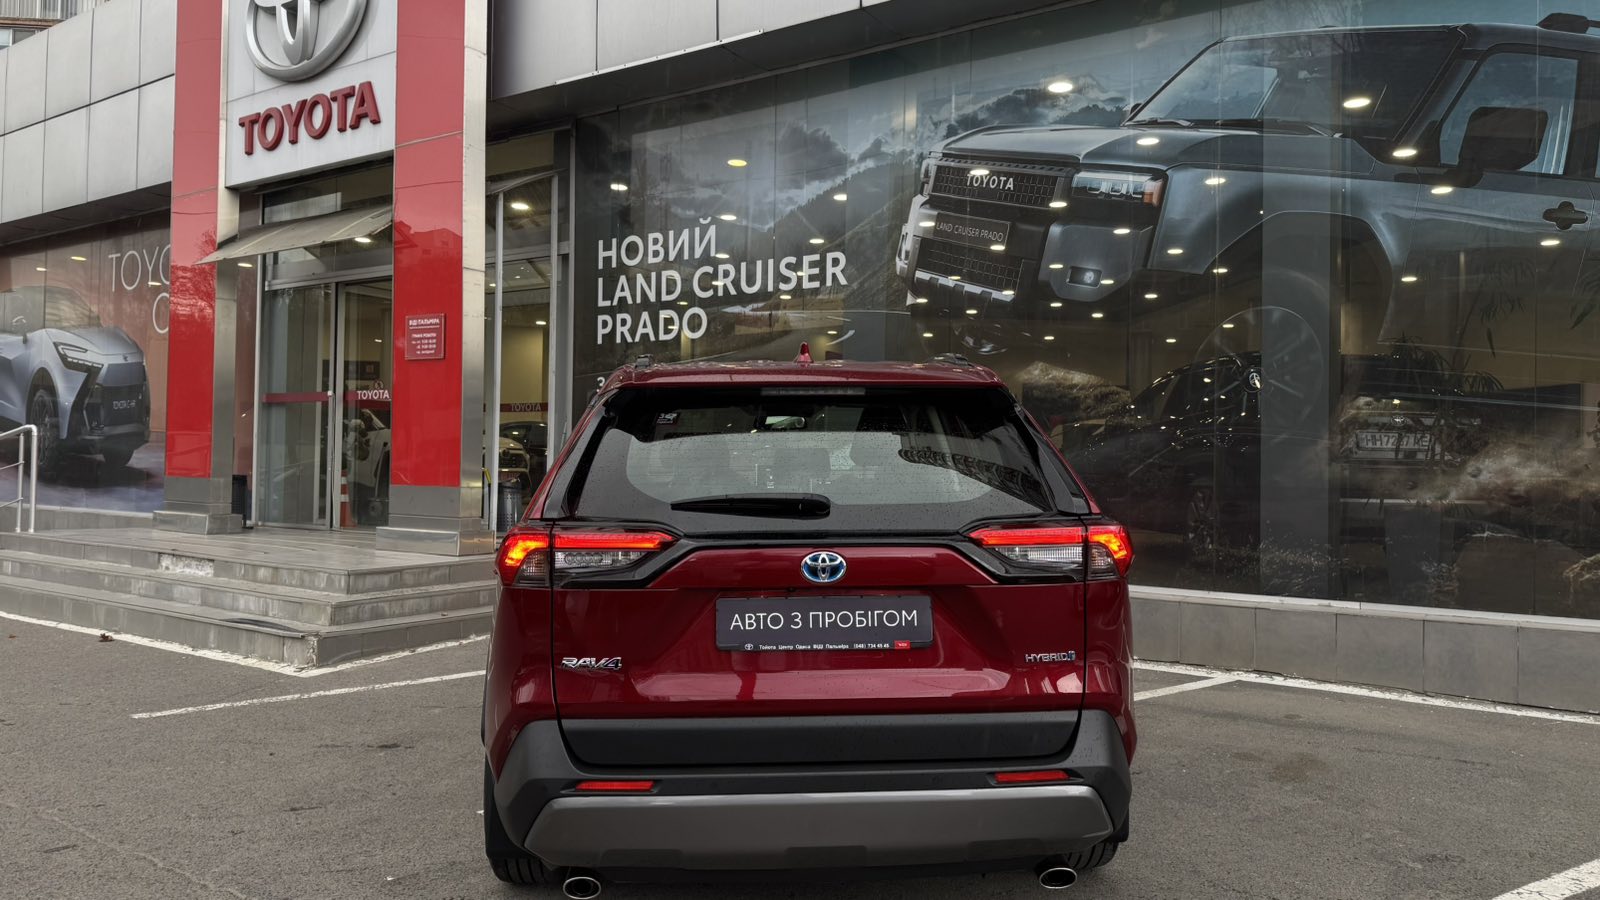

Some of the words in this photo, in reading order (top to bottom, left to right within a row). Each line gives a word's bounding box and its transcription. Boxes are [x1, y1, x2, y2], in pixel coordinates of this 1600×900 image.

[238, 81, 381, 156] TOYOTA
[966, 173, 1014, 191] TOYOTA
[936, 221, 953, 232] LAND
[953, 225, 980, 238] CRUISER
[980, 229, 1004, 242] PRADO
[597, 216, 717, 270] НОВИЙ
[597, 269, 682, 307] LAND
[692, 251, 848, 299] CRUISER
[597, 306, 708, 345] PRADO
[357, 389, 390, 400] TOYOTA
[511, 403, 542, 412] TOYOTA
[729, 612, 784, 631] АВТО
[809, 609, 918, 629] ПРОБІГОМ
[561, 656, 622, 671] RAV4
[1025, 652, 1068, 662] HYBRID
